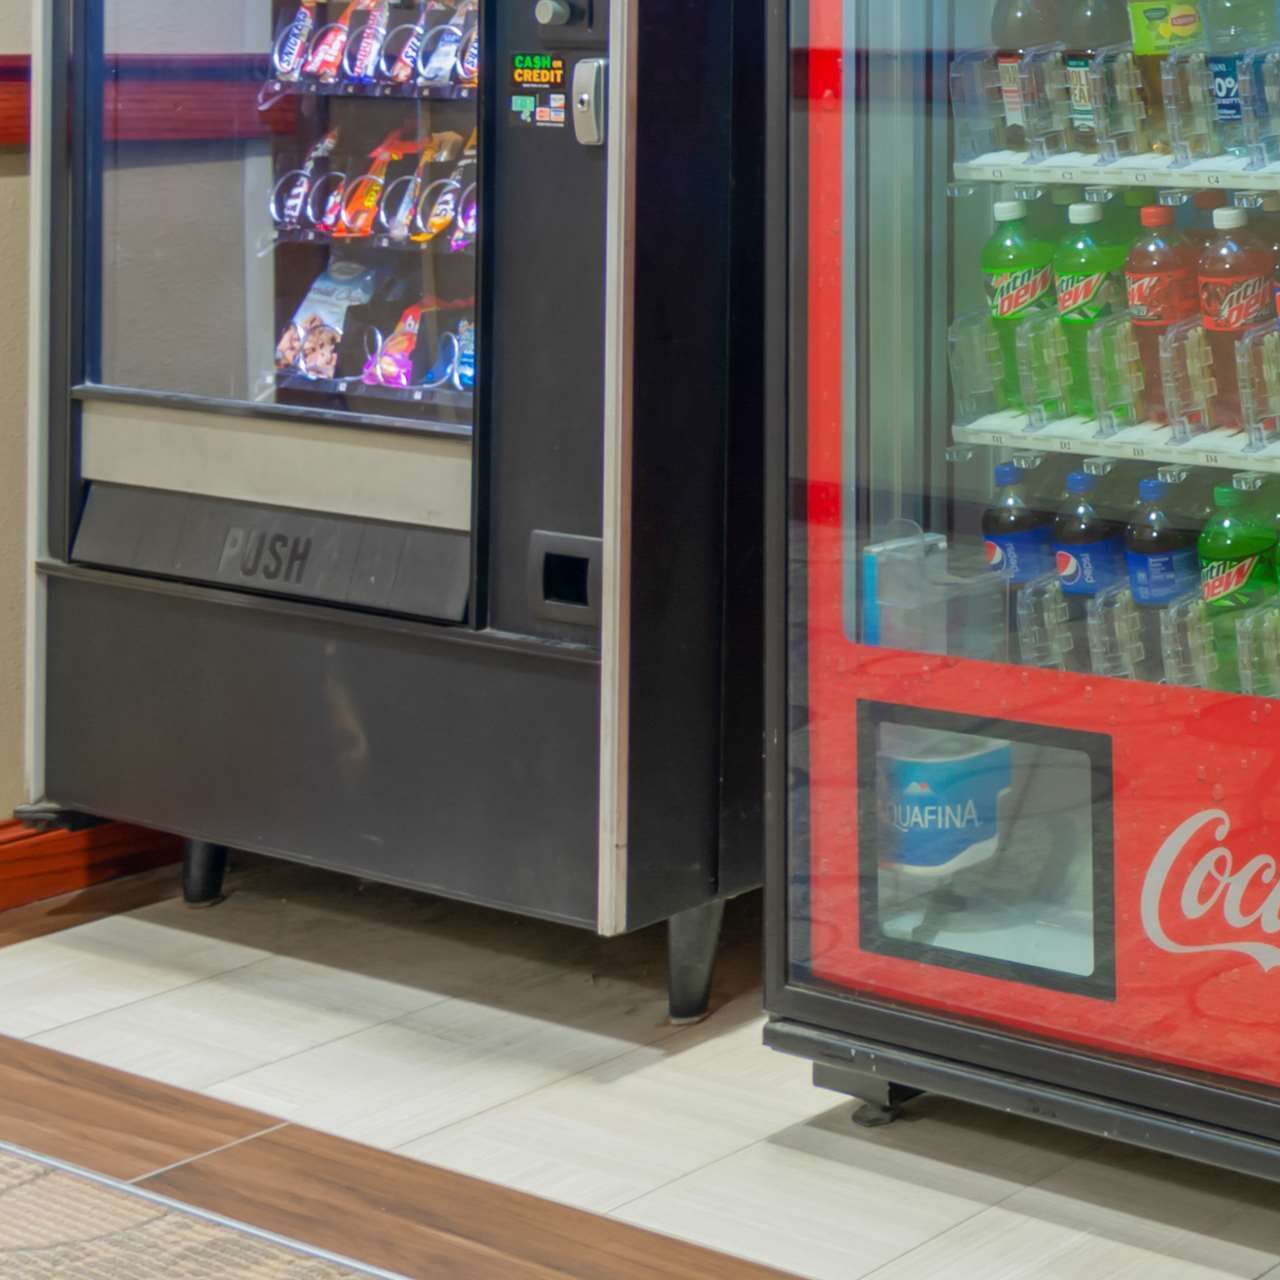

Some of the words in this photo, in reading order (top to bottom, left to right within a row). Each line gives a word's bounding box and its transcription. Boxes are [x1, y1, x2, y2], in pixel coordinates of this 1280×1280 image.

[514, 55, 551, 68] CASH
[513, 69, 563, 83] CREDIT
[992, 170, 1003, 179] C1
[1062, 172, 1073, 181] C2
[1135, 174, 1146, 182] C3
[1208, 175, 1220, 185] C4
[217, 526, 313, 585] PUSH
[886, 800, 980, 833] QUAFINA
